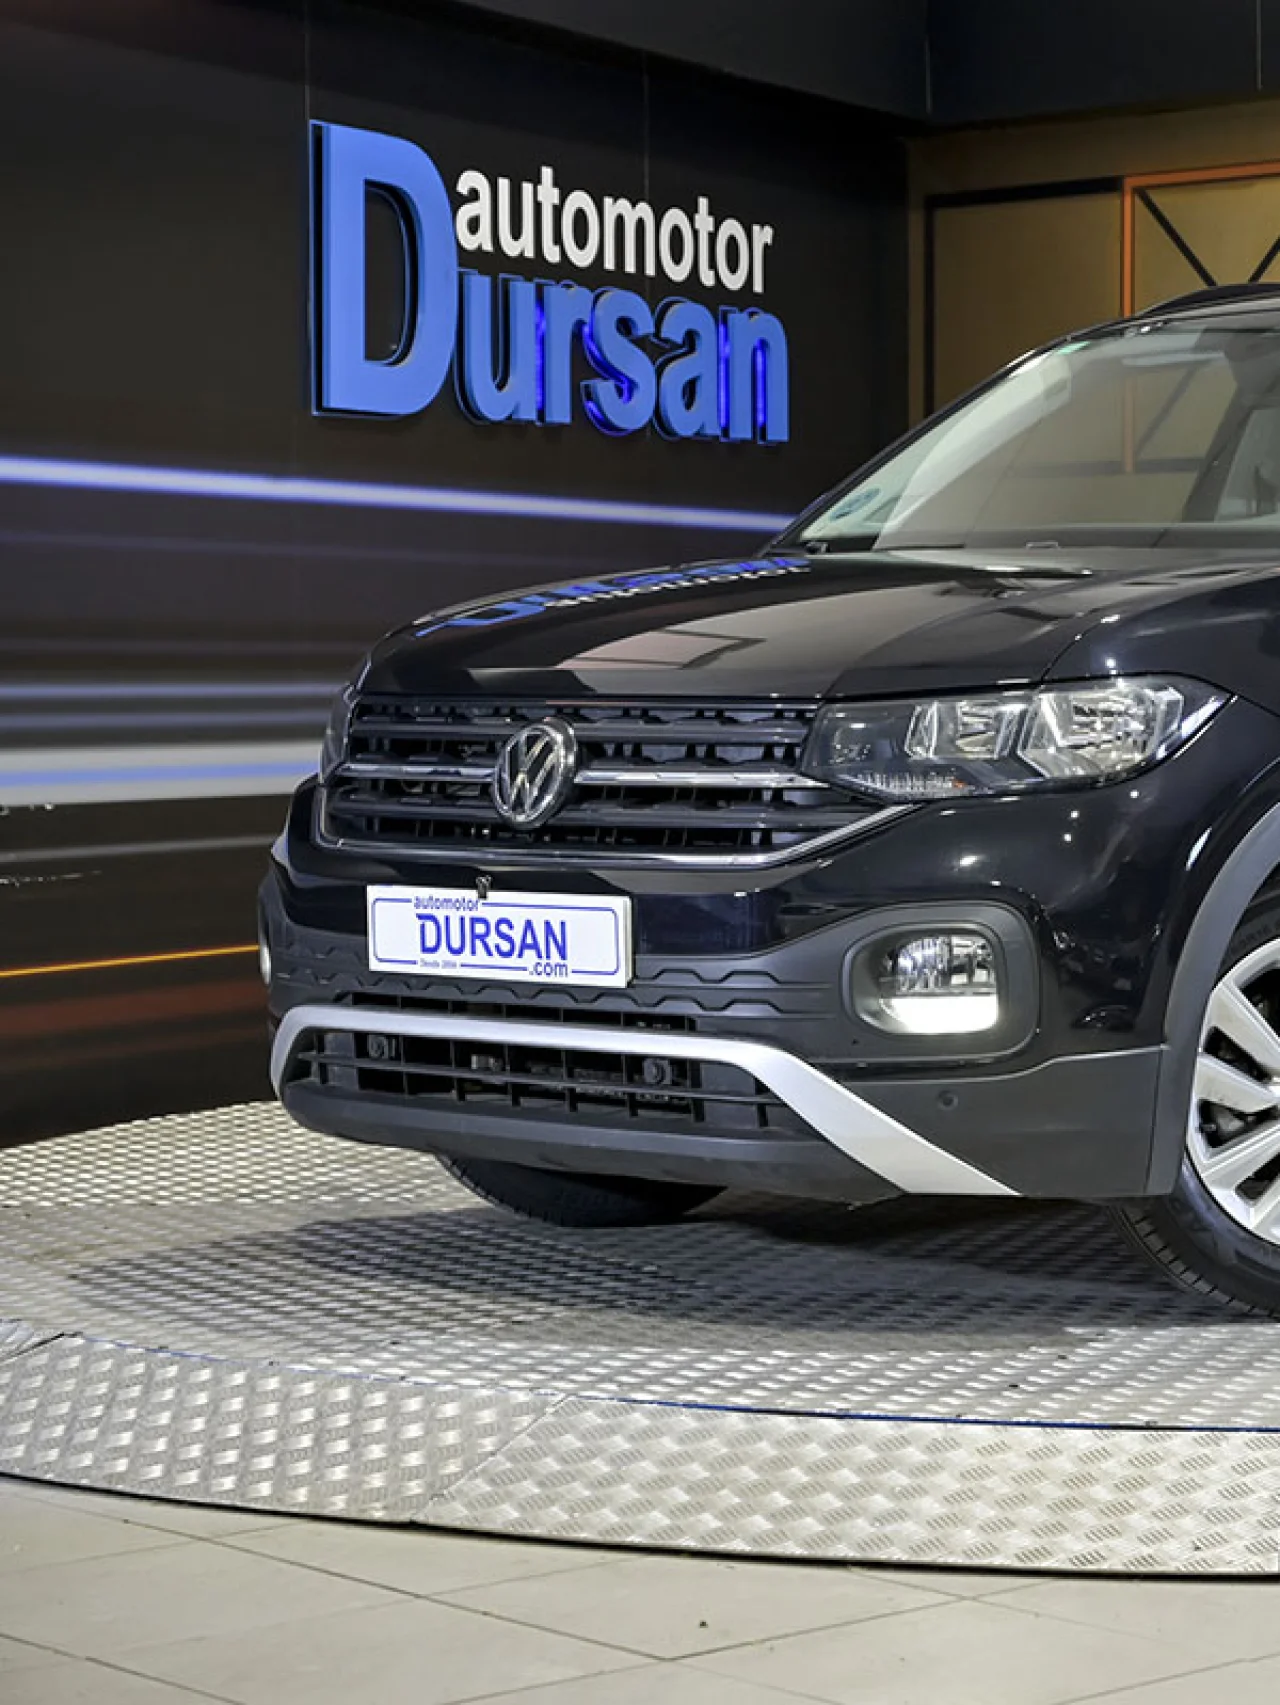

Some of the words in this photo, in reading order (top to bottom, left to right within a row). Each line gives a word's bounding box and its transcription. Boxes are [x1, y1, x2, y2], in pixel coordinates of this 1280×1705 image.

[455, 166, 774, 293] automotor
[309, 119, 789, 444] Dursan
[414, 895, 479, 911] automotor
[415, 912, 568, 961] DURSAN
[529, 960, 569, 977] .com
